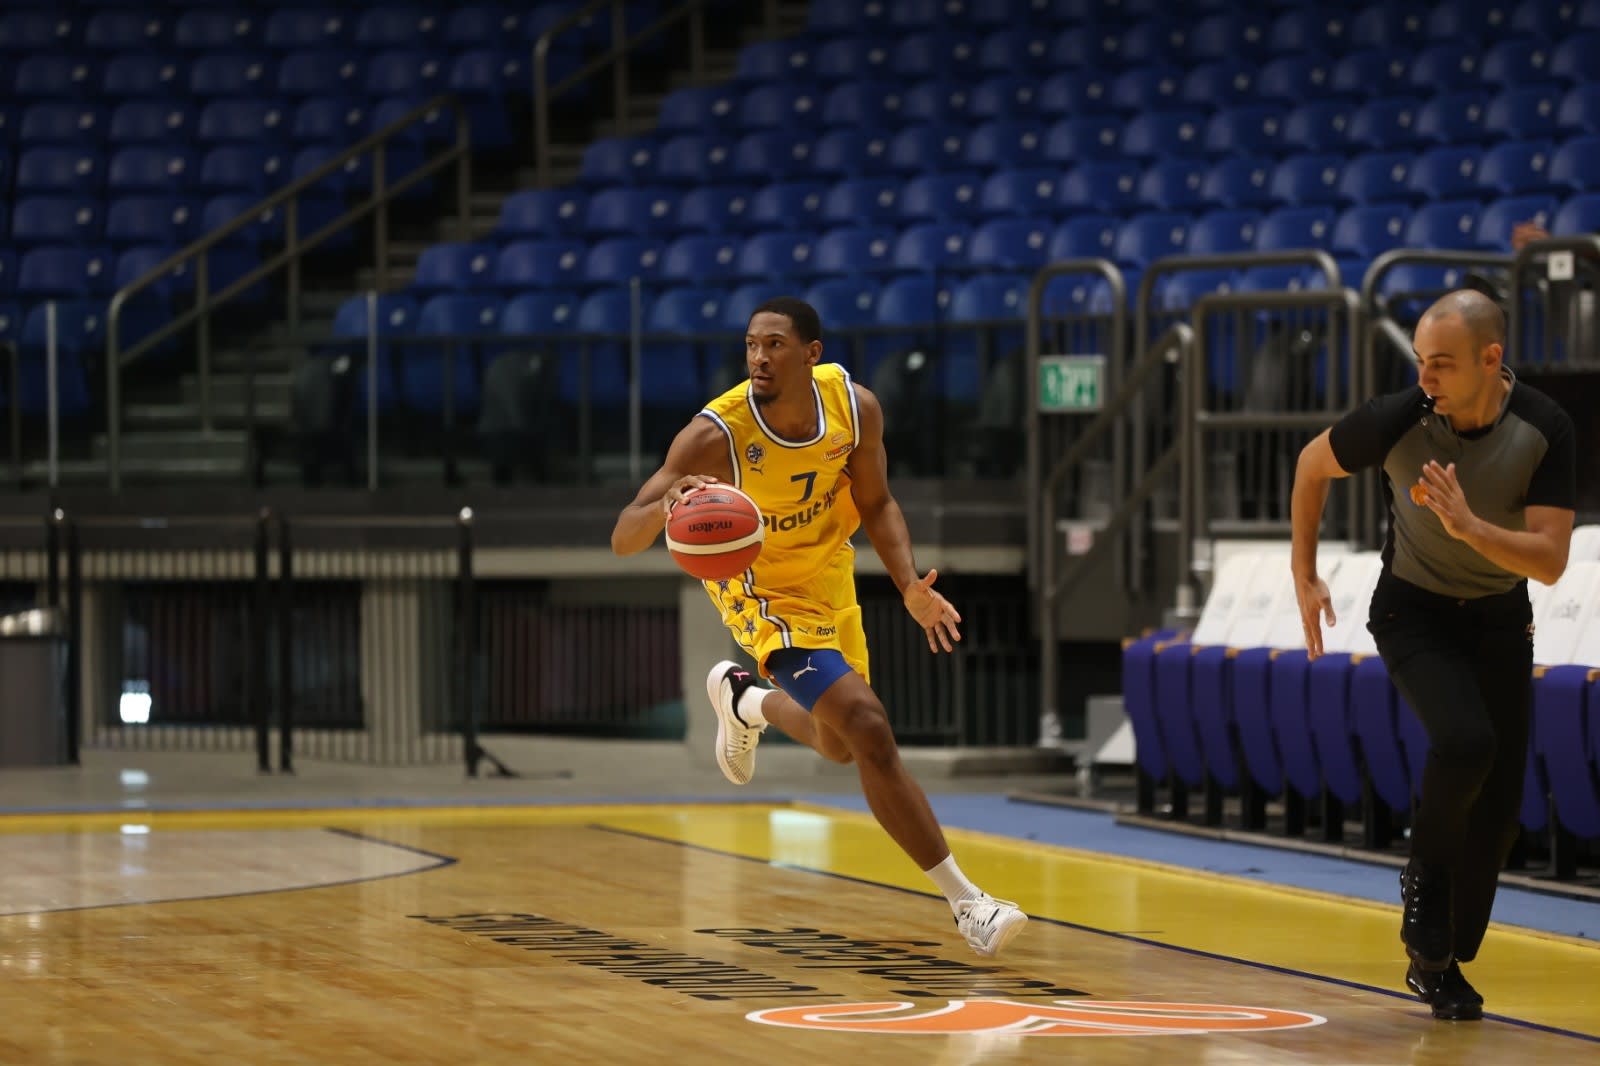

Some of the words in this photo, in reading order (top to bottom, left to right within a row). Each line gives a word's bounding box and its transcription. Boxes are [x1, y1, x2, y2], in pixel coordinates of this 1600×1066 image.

[790, 470, 818, 504] 7
[689, 520, 732, 533] molten
[406, 913, 669, 951] AIRLINES
[552, 953, 845, 1001] TURKISH
